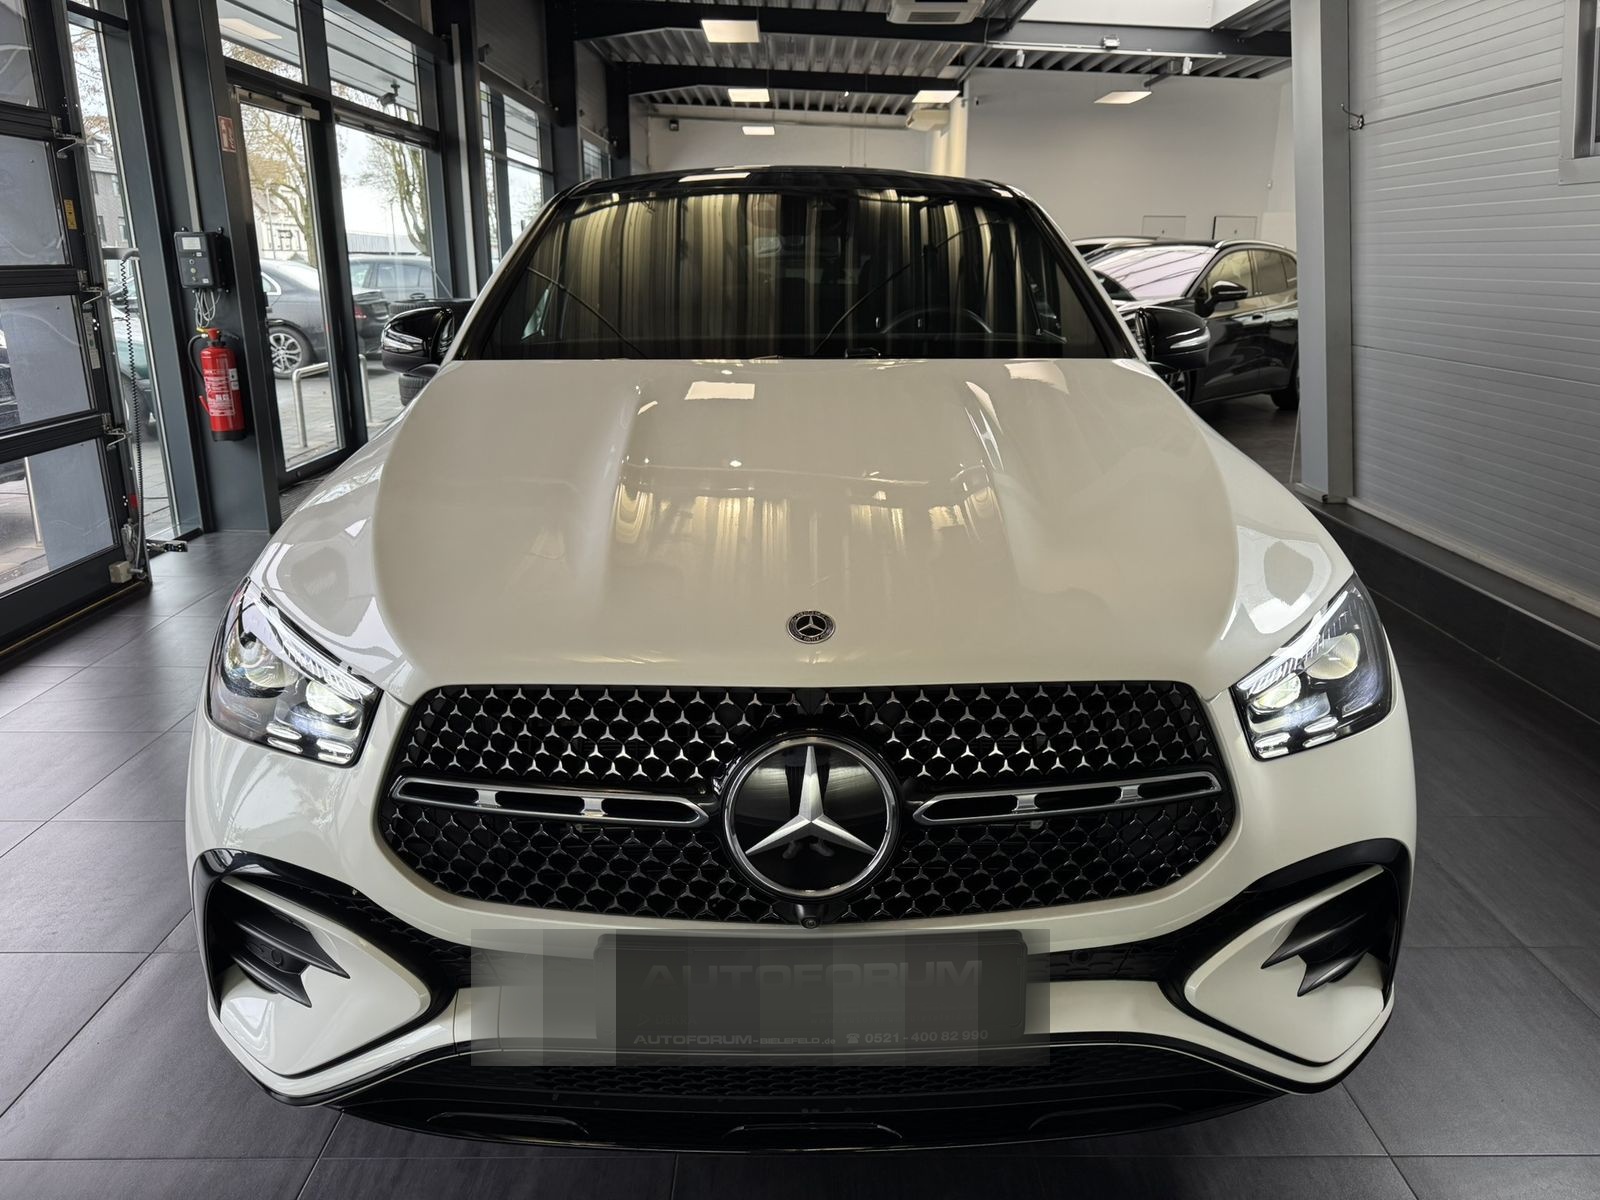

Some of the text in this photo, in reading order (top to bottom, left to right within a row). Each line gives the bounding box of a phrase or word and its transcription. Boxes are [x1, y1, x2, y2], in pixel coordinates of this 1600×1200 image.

[640, 960, 982, 990] AUTOFORUM
[864, 1032, 899, 1043] 0521
[910, 1031, 938, 1042] 400
[940, 1031, 959, 1041] 82
[961, 1029, 989, 1040] 990
